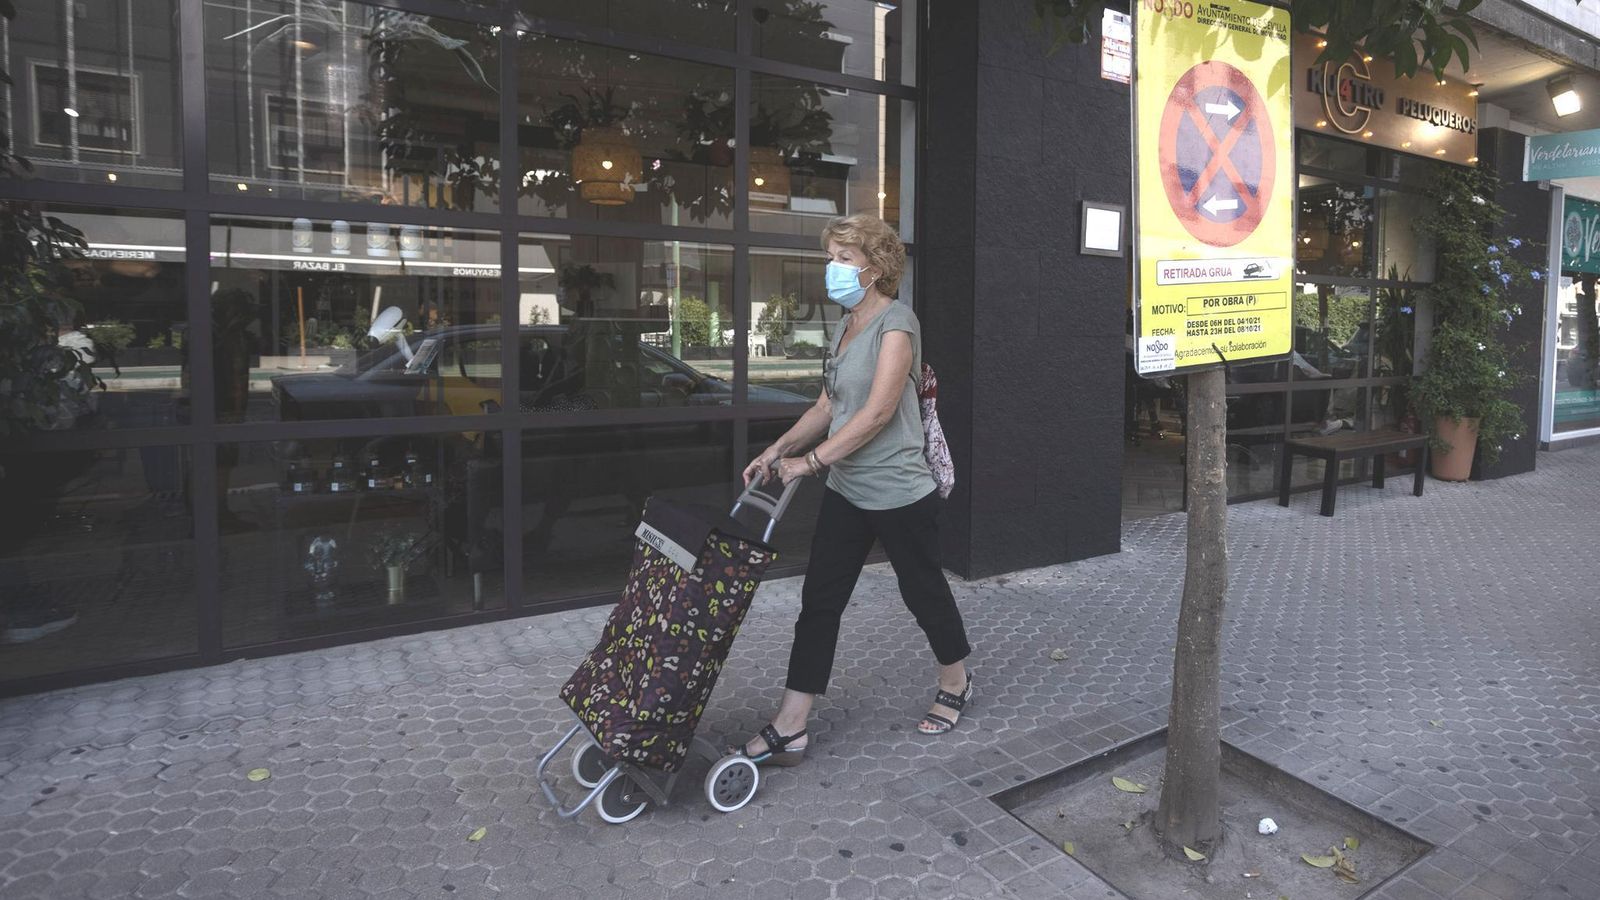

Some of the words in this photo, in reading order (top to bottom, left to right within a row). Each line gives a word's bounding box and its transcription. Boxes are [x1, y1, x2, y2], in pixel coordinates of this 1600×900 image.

[1197, 4, 1251, 26] AYUNTAMIENTO
[1263, 18, 1287, 33] SEVILLA
[1197, 17, 1227, 29] DIRECÓN
[1228, 23, 1252, 34] GENERAL
[1400, 98, 1477, 135] PELUQUEROS
[1163, 268, 1207, 279] RETIRADA
[1208, 267, 1233, 277] GRUA
[1151, 303, 1186, 315] MOTIVO:
[1203, 297, 1220, 308] POR
[1222, 296, 1244, 306] OBRA
[1246, 295, 1257, 306] (P)
[1151, 328, 1175, 336] FECHA:
[1186, 320, 1208, 328] DESDE
[1209, 319, 1222, 327] 06H
[1186, 328, 1209, 336] HASTA
[1174, 347, 1218, 360] Agradecemo
[1229, 341, 1267, 352] colaboración
